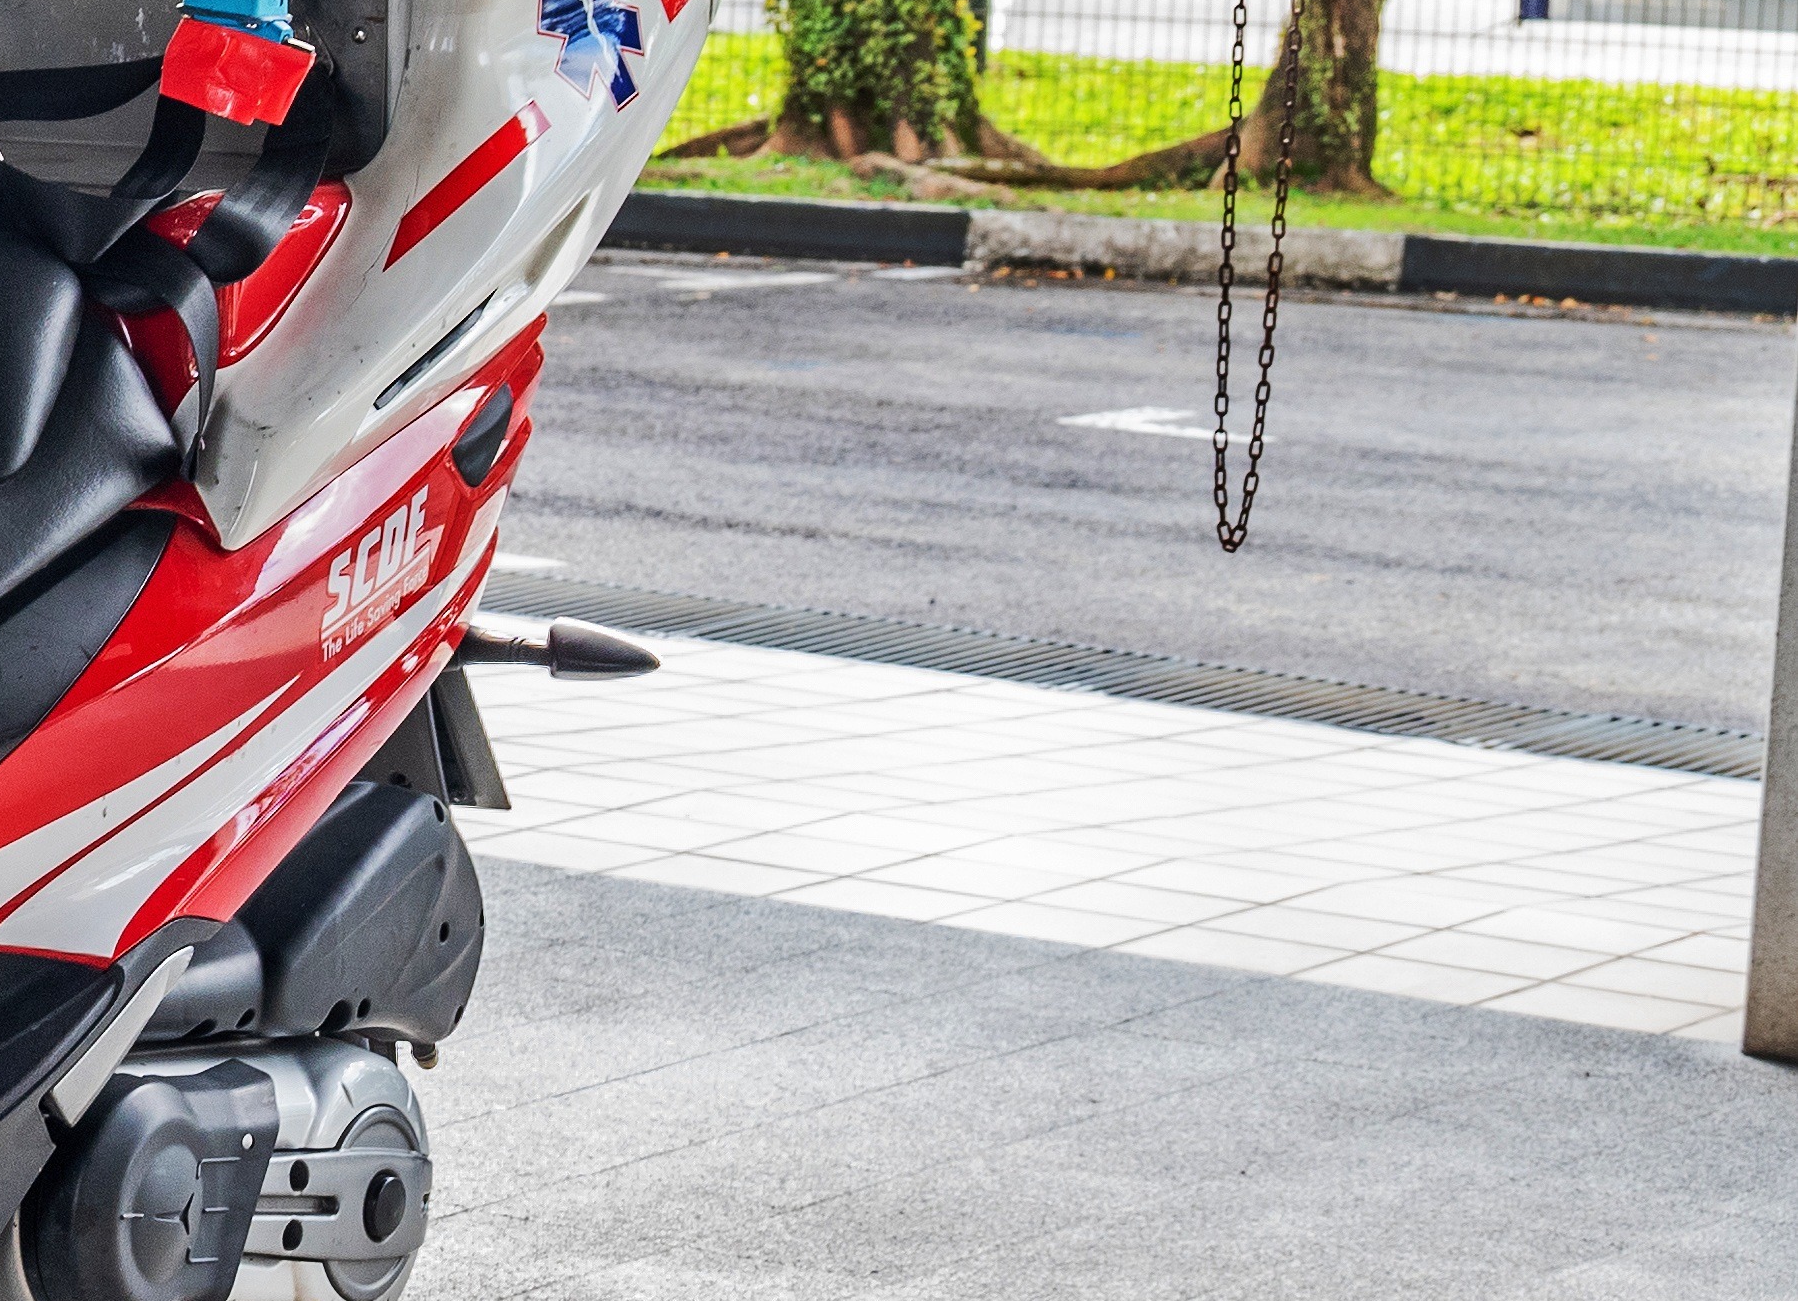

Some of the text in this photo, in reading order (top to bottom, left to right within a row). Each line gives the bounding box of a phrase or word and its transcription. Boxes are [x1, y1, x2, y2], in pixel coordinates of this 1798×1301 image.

[321, 484, 429, 630] SCDF
[322, 566, 428, 662] The Life Saving Force
